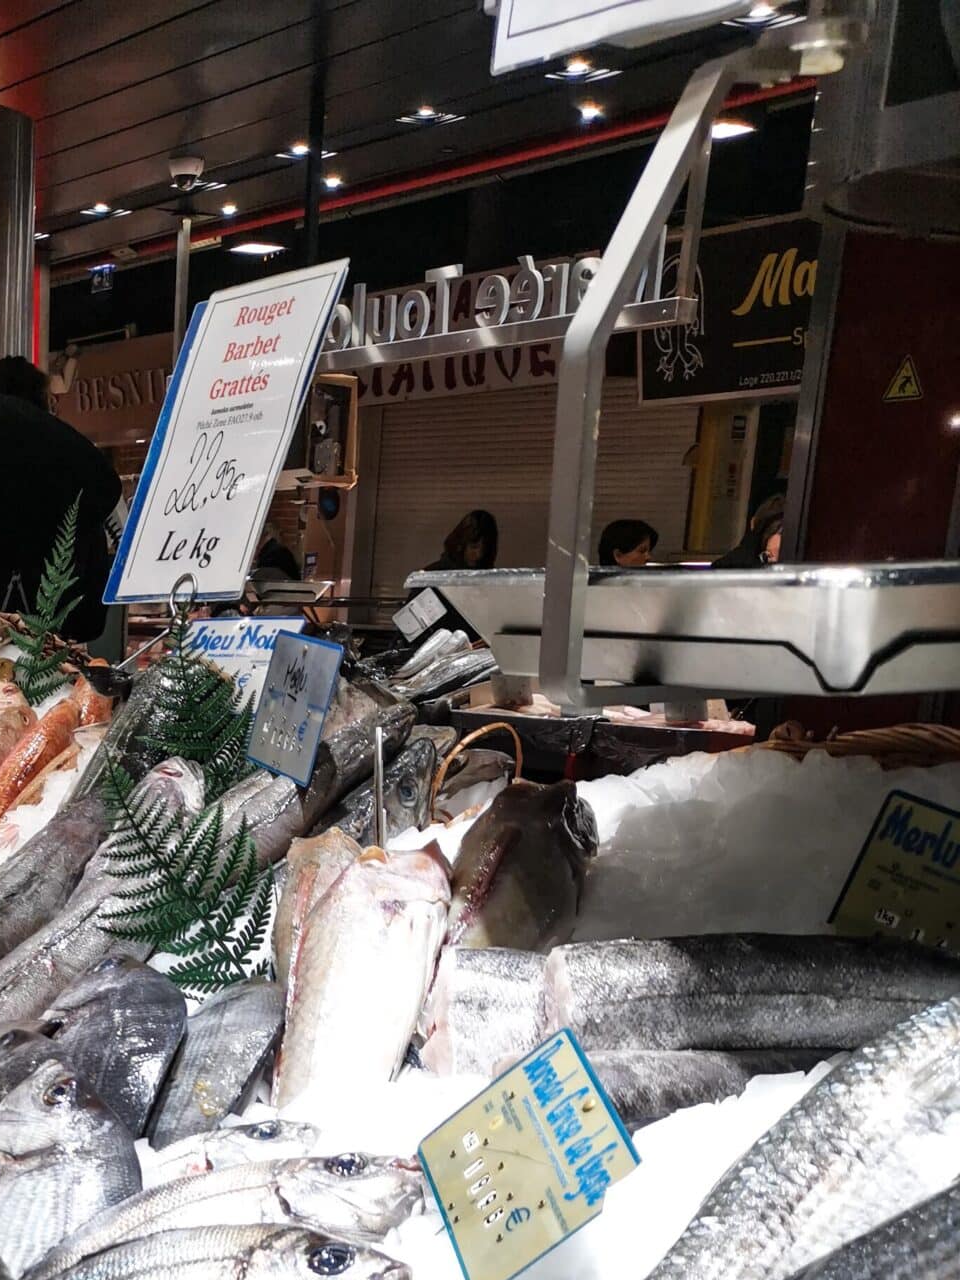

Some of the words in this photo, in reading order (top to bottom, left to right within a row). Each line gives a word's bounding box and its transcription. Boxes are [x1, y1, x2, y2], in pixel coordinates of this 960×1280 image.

[234, 296, 296, 326] Rouget
[223, 334, 281, 363] Barbet
[76, 369, 168, 413] BESNI
[209, 369, 270, 400] Grattés
[156, 531, 188, 562] Le
[190, 528, 220, 568] kg
